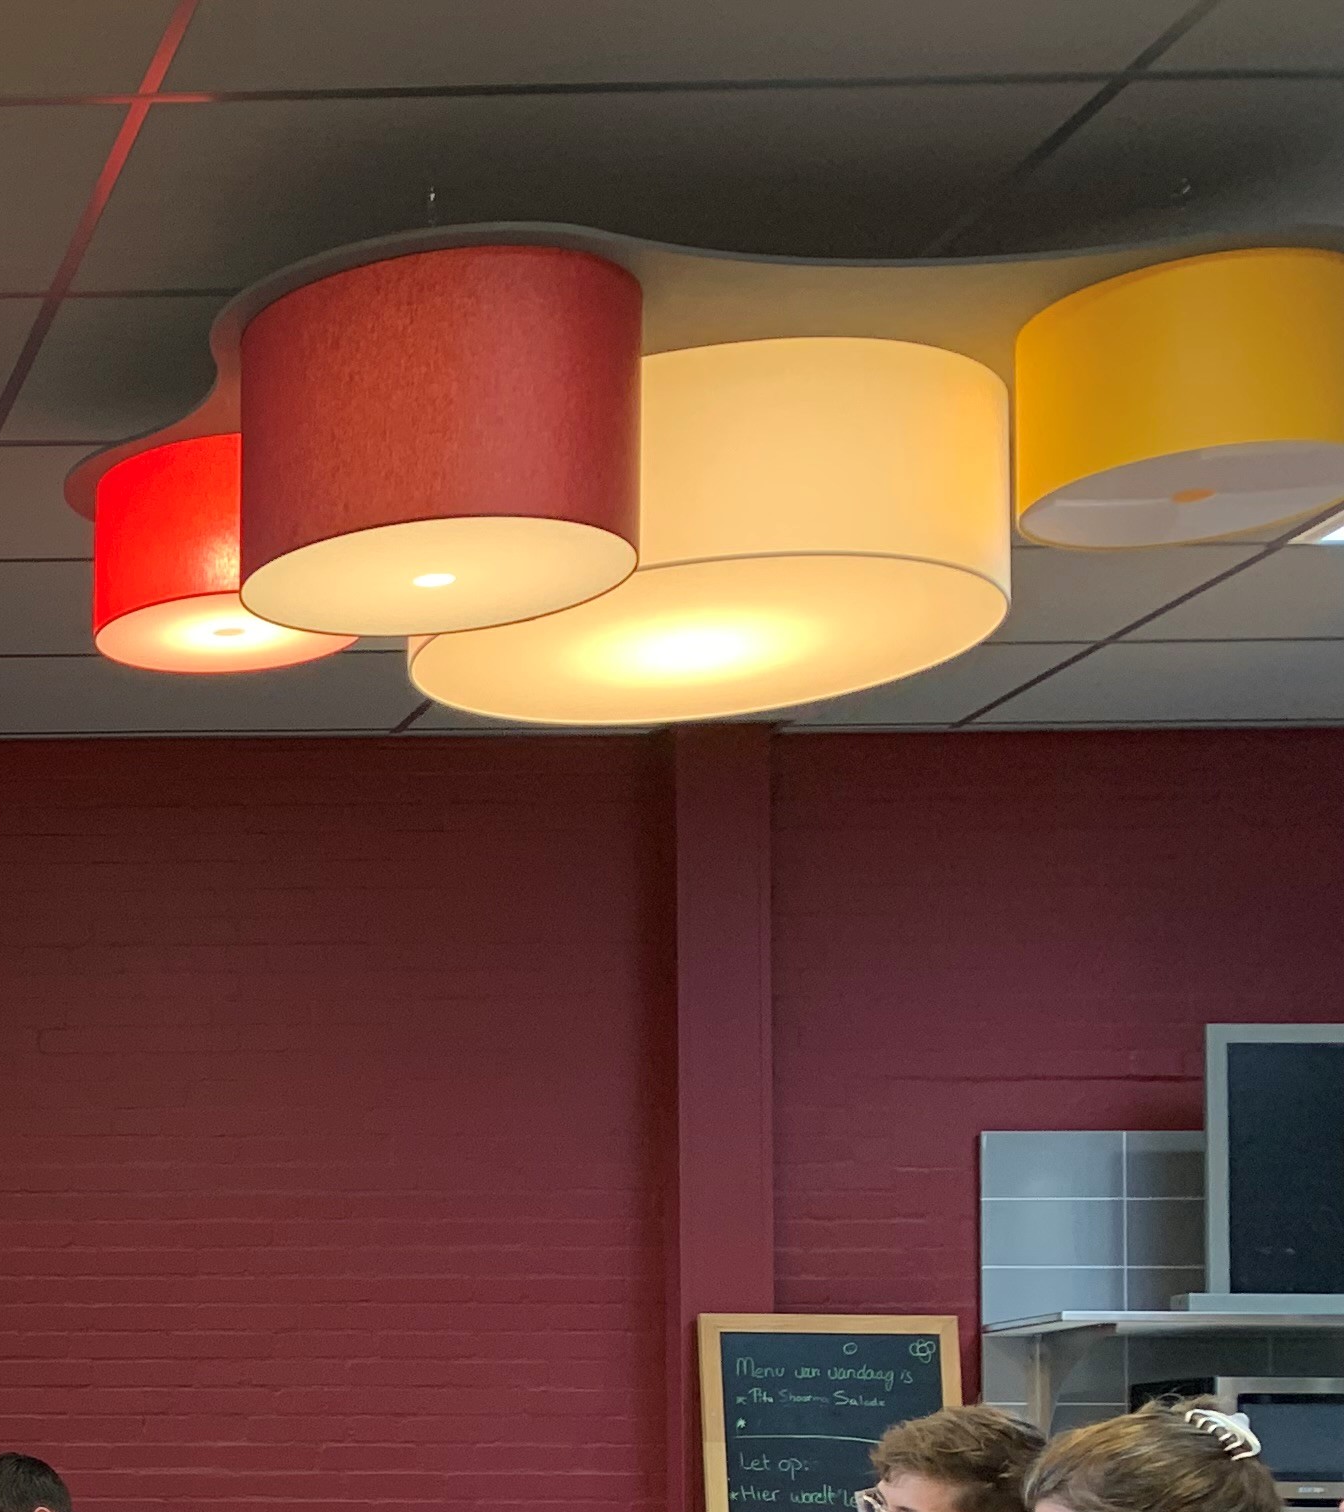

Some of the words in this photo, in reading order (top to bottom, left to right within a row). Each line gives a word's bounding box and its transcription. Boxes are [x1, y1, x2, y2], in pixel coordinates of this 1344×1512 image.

[736, 1357, 785, 1378] Menu
[795, 1366, 821, 1379] van
[828, 1361, 894, 1390] vandaag
[900, 1369, 914, 1384] is
[740, 1453, 770, 1470] Let
[741, 1485, 778, 1502] Hier
